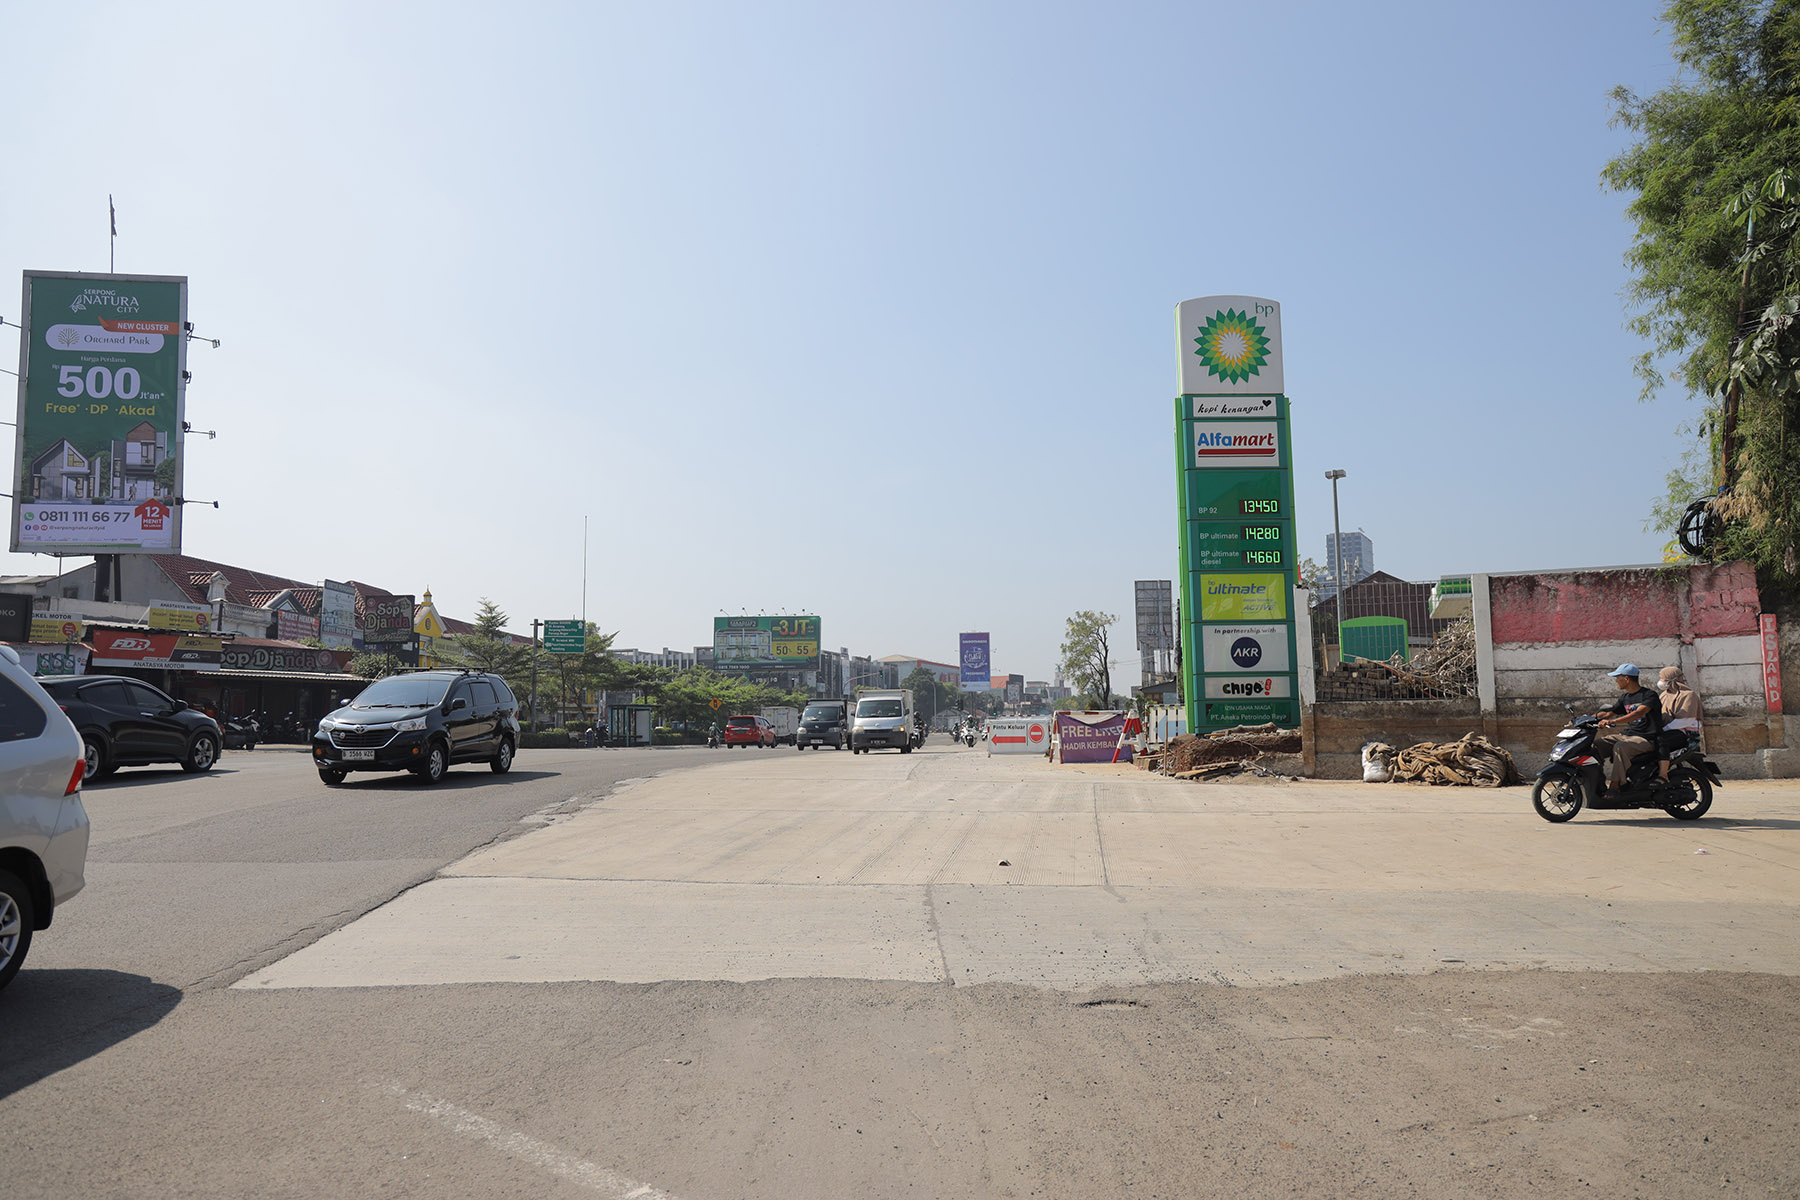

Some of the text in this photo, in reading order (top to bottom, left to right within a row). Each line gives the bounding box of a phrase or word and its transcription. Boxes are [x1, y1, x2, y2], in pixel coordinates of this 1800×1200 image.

[83, 295, 139, 306] NATURA
[1255, 302, 1274, 317] bp
[57, 365, 140, 399] 500
[1198, 403, 1264, 414] kopi kenangan
[1198, 433, 1274, 446] Alfamart
[145, 506, 160, 518] 12
[1244, 501, 1278, 512] 13450
[39, 511, 130, 522] 0811 111 66 77
[1245, 528, 1279, 540] 14280
[1246, 551, 1280, 563] 14660
[1208, 583, 1266, 594] ultimate
[377, 603, 400, 617] Sop
[366, 612, 409, 631] Djanda
[110, 639, 151, 650] FDR
[776, 646, 788, 655] 50
[797, 646, 809, 655] 55
[253, 649, 315, 669] Djanda
[1233, 648, 1258, 658] AKR
[1062, 726, 1092, 738] FREE
